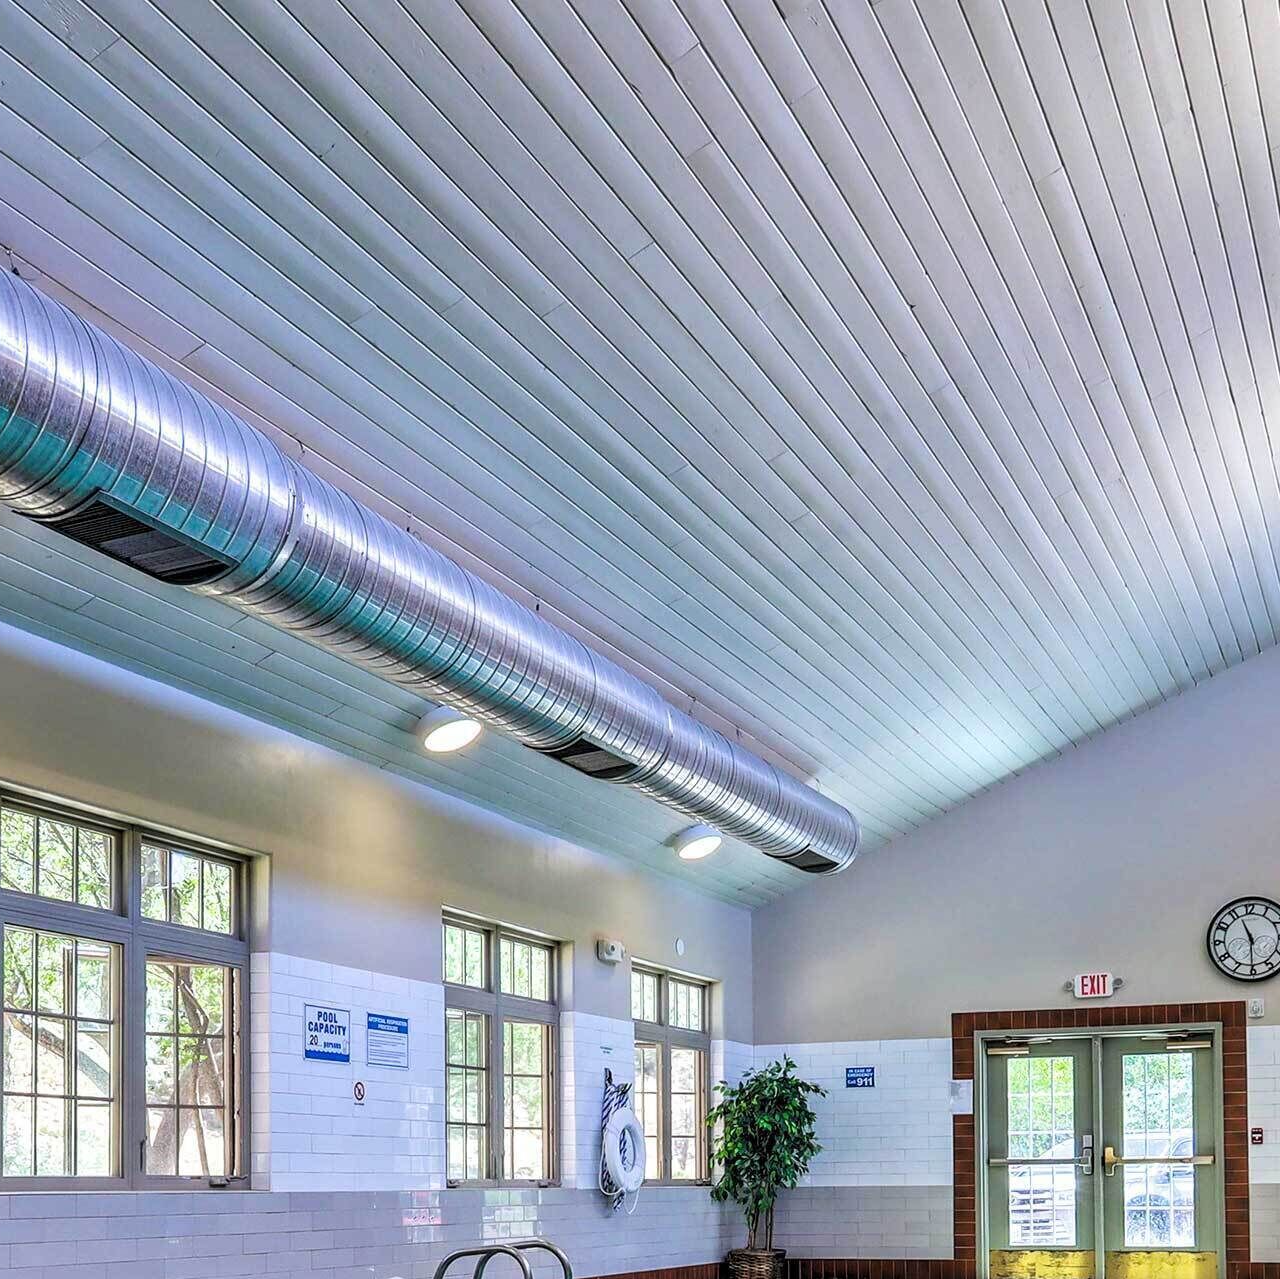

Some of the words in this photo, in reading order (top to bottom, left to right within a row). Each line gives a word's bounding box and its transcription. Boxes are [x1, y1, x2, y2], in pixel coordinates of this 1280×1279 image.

[1081, 974, 1107, 995] EXIT
[318, 1011, 338, 1023] POOL
[308, 1021, 346, 1036] CAPACITY
[310, 1035, 318, 1045] 20
[857, 1078, 872, 1086] 911
